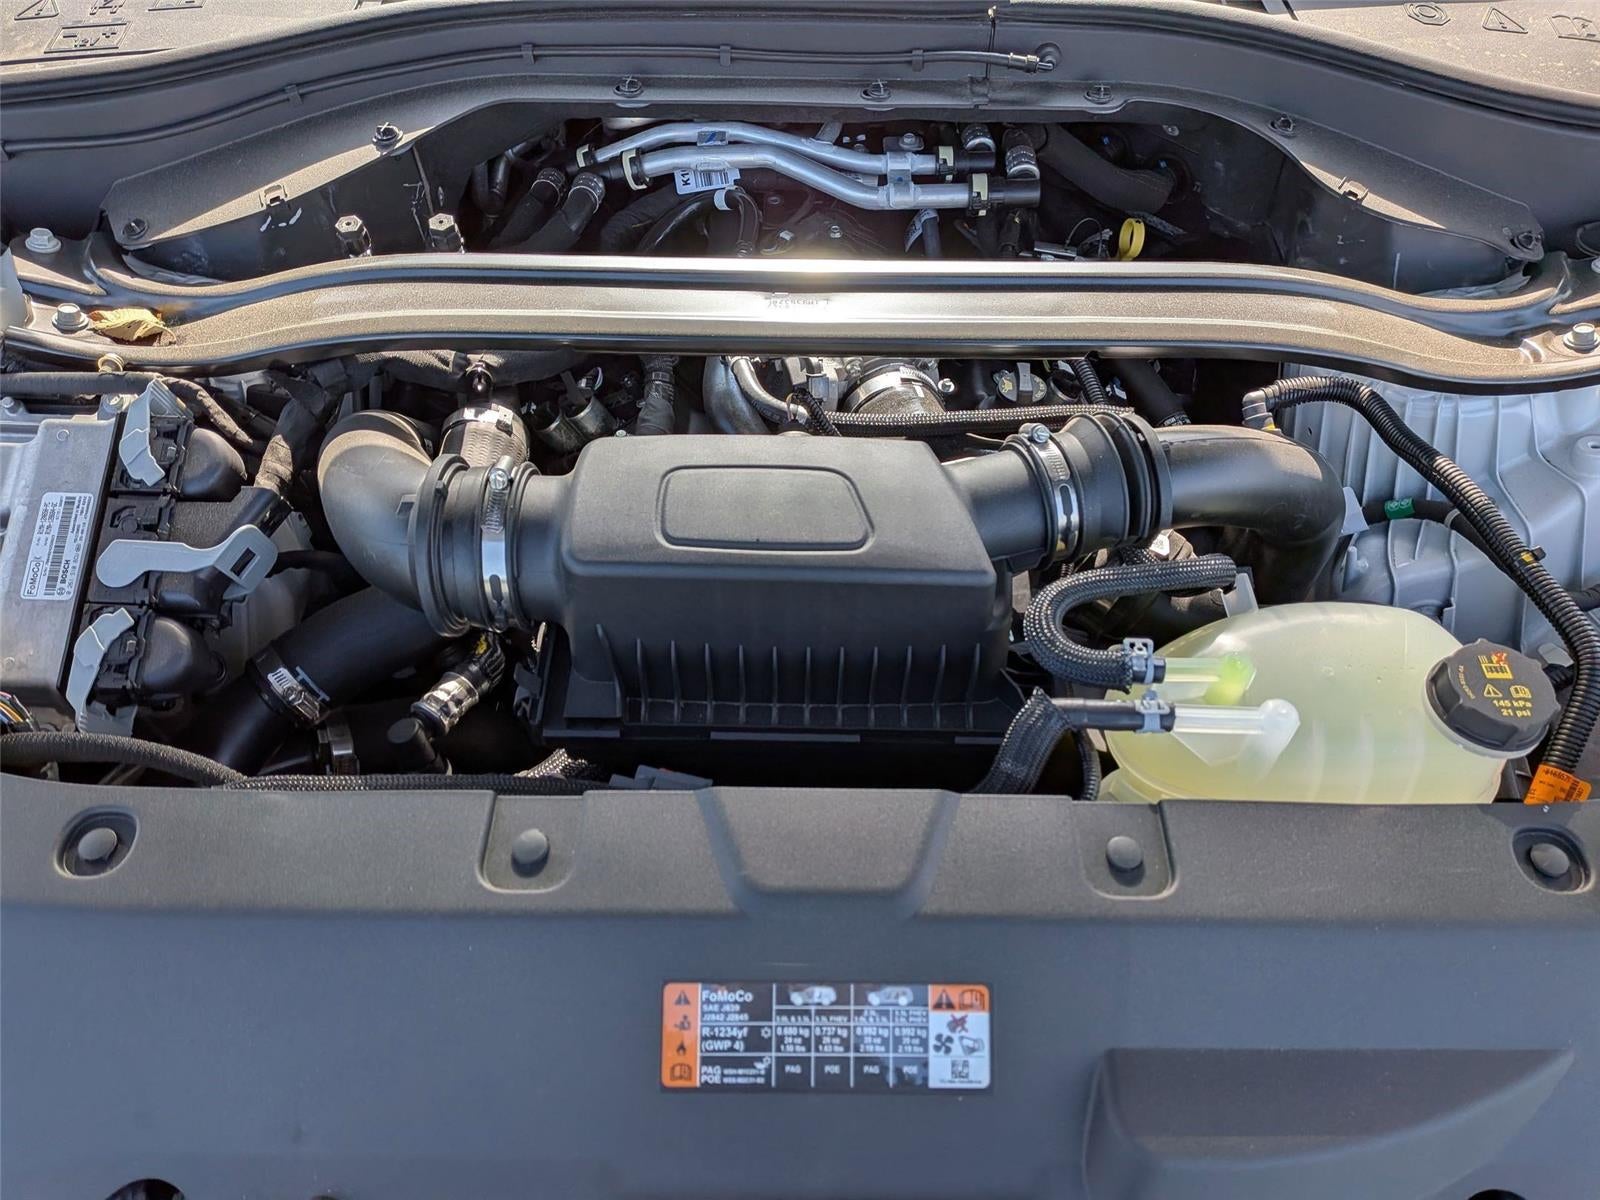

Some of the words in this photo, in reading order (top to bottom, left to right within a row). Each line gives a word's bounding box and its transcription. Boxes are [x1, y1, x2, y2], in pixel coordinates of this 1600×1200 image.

[60, 560, 71, 584] BOSCH
[27, 562, 41, 595] FoMoCo
[1501, 708, 1513, 716] 21
[1516, 709, 1531, 717] psi
[702, 989, 753, 1002] FoMoCo
[702, 1026, 748, 1039] R-1234yf
[702, 1040, 731, 1052] (GWP
[733, 1040, 744, 1052] 4)
[701, 1066, 721, 1075] PAG
[701, 1075, 721, 1084] POE
